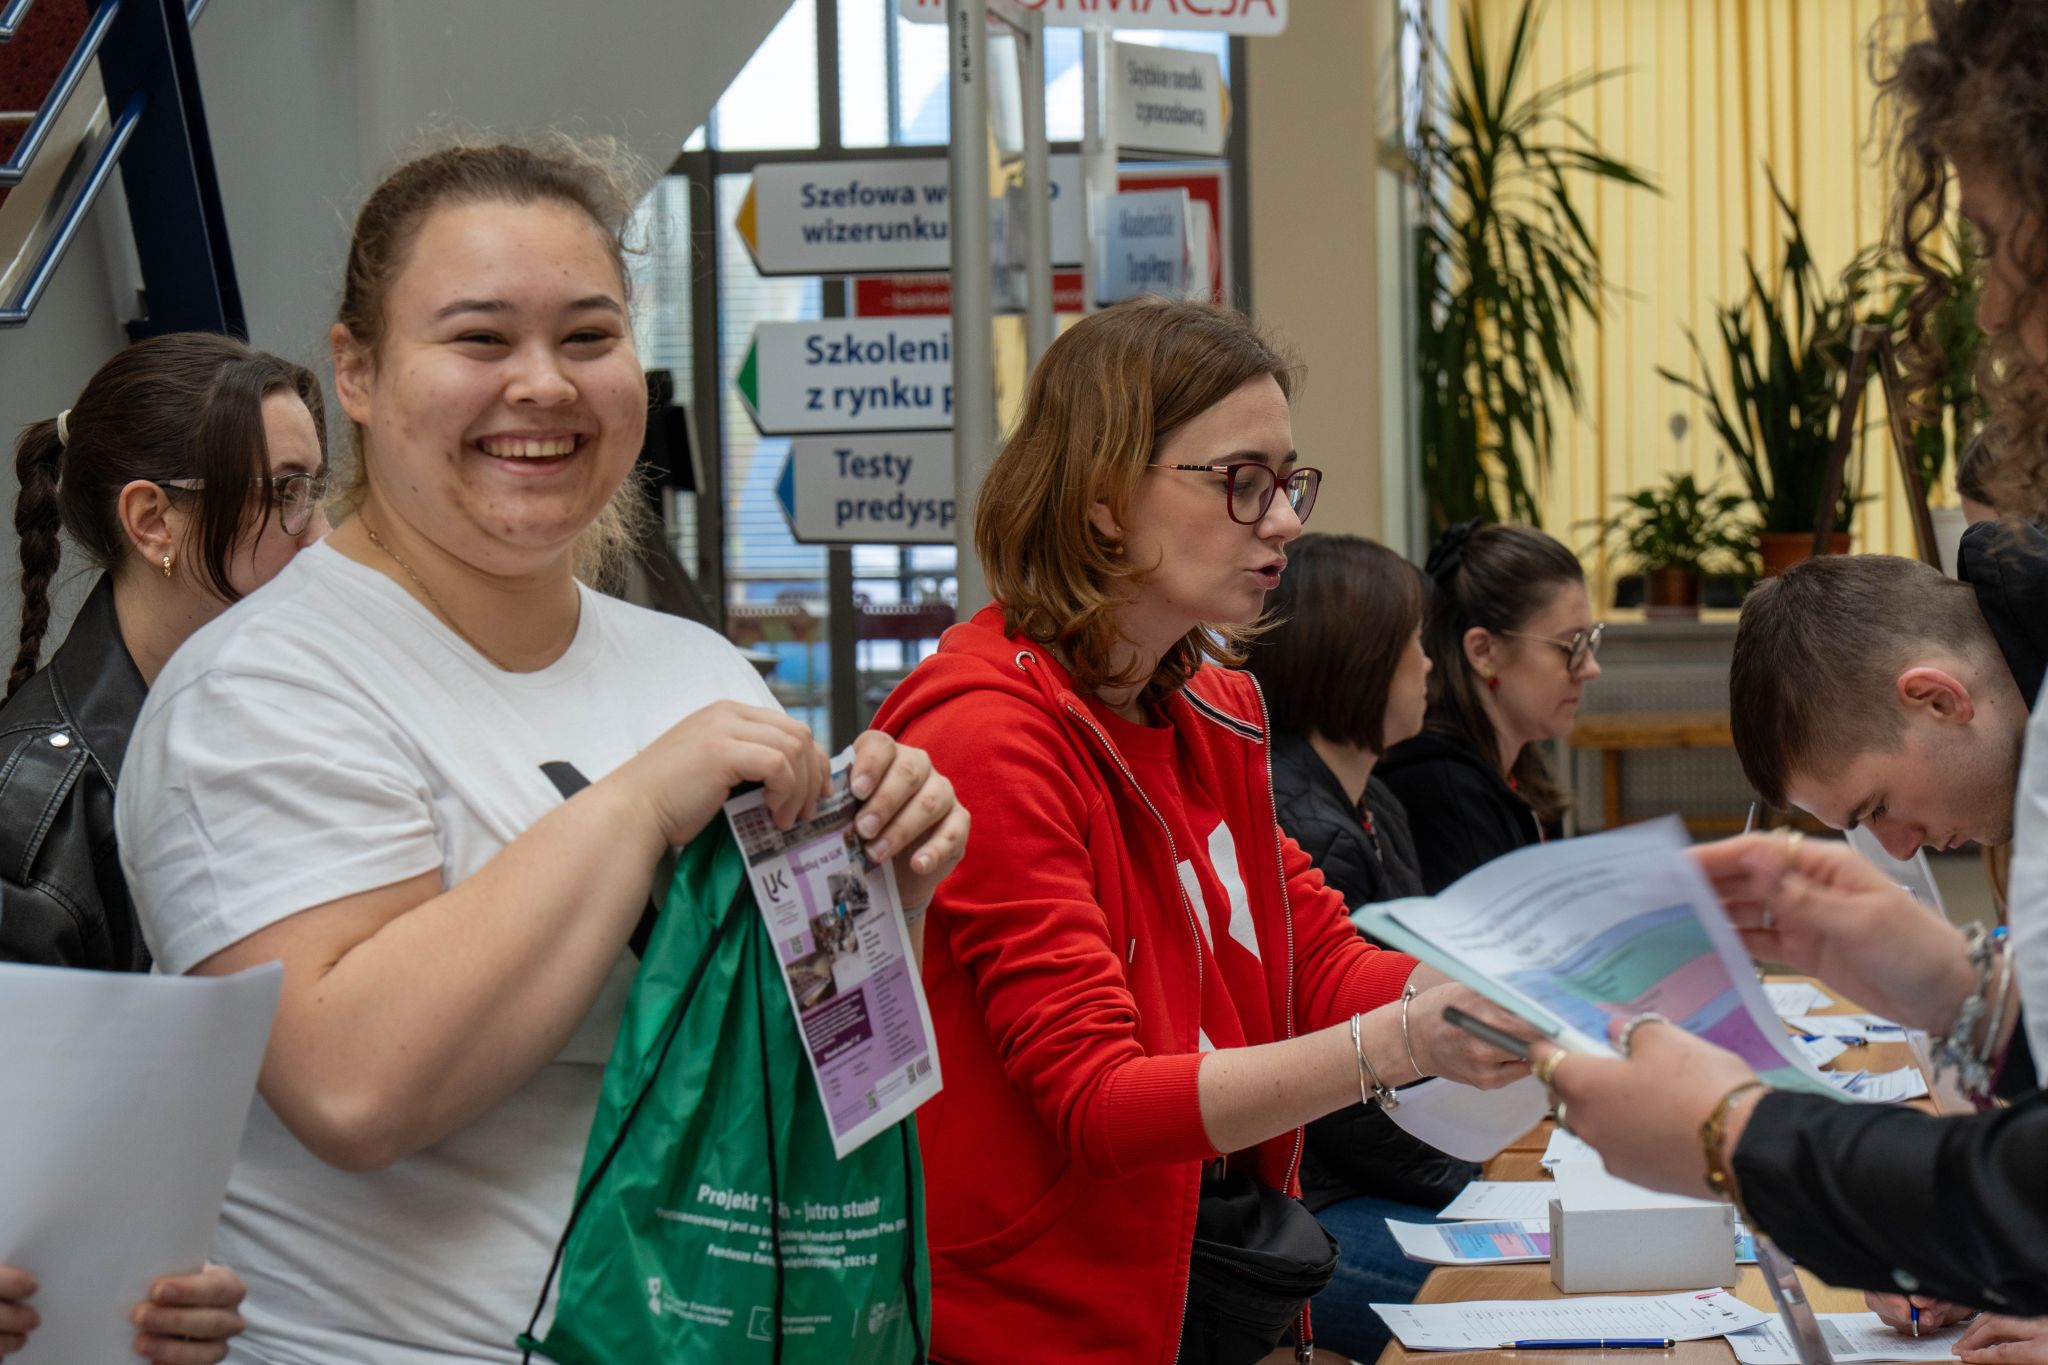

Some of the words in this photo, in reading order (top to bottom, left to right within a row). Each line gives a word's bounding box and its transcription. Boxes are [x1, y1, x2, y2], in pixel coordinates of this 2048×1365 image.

[801, 181, 916, 209] Szefowa
[802, 214, 948, 244] wizerunku
[806, 332, 949, 366] Szkoleni
[806, 387, 824, 411] z
[833, 376, 933, 417] rynku
[833, 448, 913, 486] Testy
[836, 492, 956, 529] predysp
[697, 1184, 759, 1212] Projekt
[804, 1200, 839, 1223] jutro
